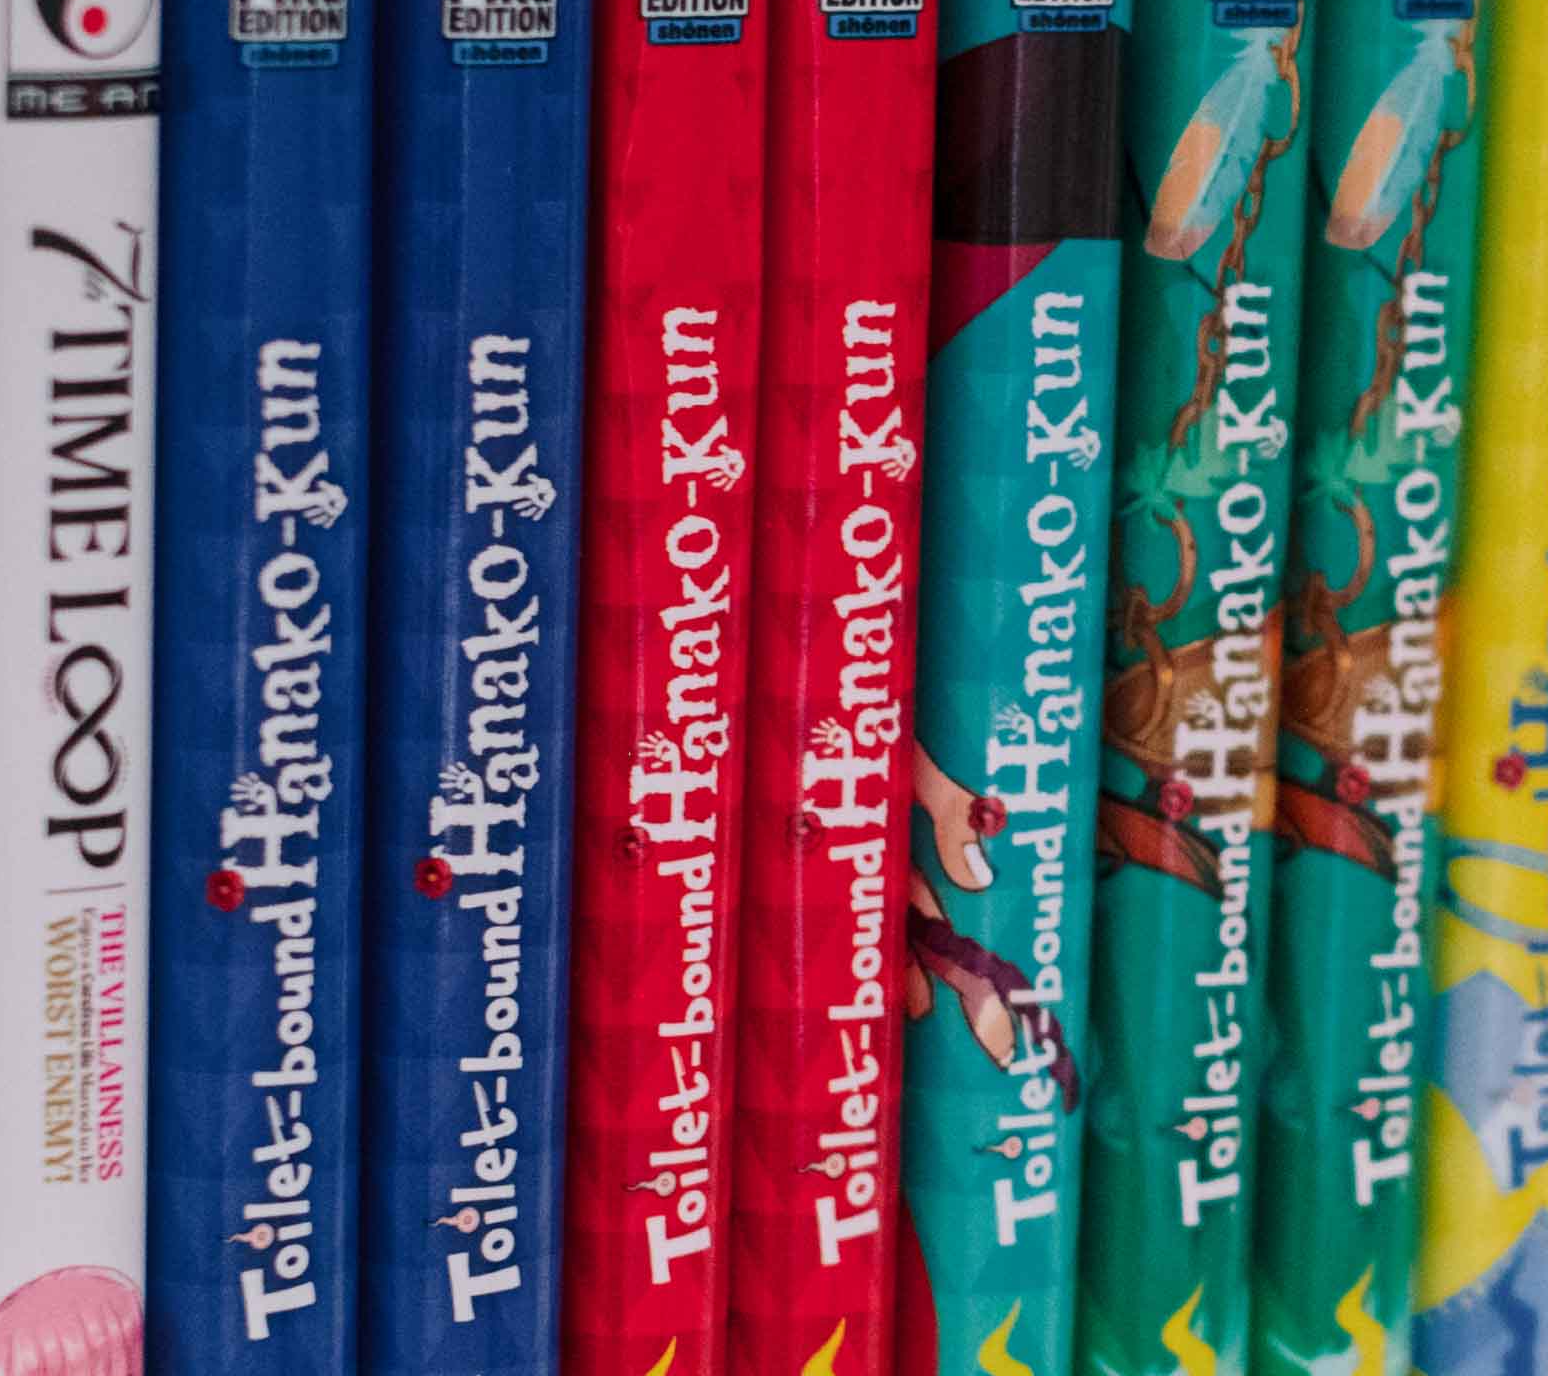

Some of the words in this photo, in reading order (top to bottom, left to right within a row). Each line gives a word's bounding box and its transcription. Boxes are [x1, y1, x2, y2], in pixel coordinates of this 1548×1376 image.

[239, 8, 342, 33] EDITION
[451, 7, 551, 33] EDITION
[49, 302, 134, 562] TIME
[43, 914, 77, 1040] WORST
[98, 903, 127, 975] THE
[814, 840, 888, 1269] Toilet-bound
[990, 827, 1066, 1247] Toilet-bound
[1174, 816, 1253, 1229] Toilet-bound
[42, 1053, 76, 1184] ENEMY!
[97, 980, 126, 1183] VILLAINESS
[236, 901, 320, 1342] Toilet-bound
[444, 888, 528, 1324] Toilet-bound
[642, 856, 716, 1286] Toilet-bound
